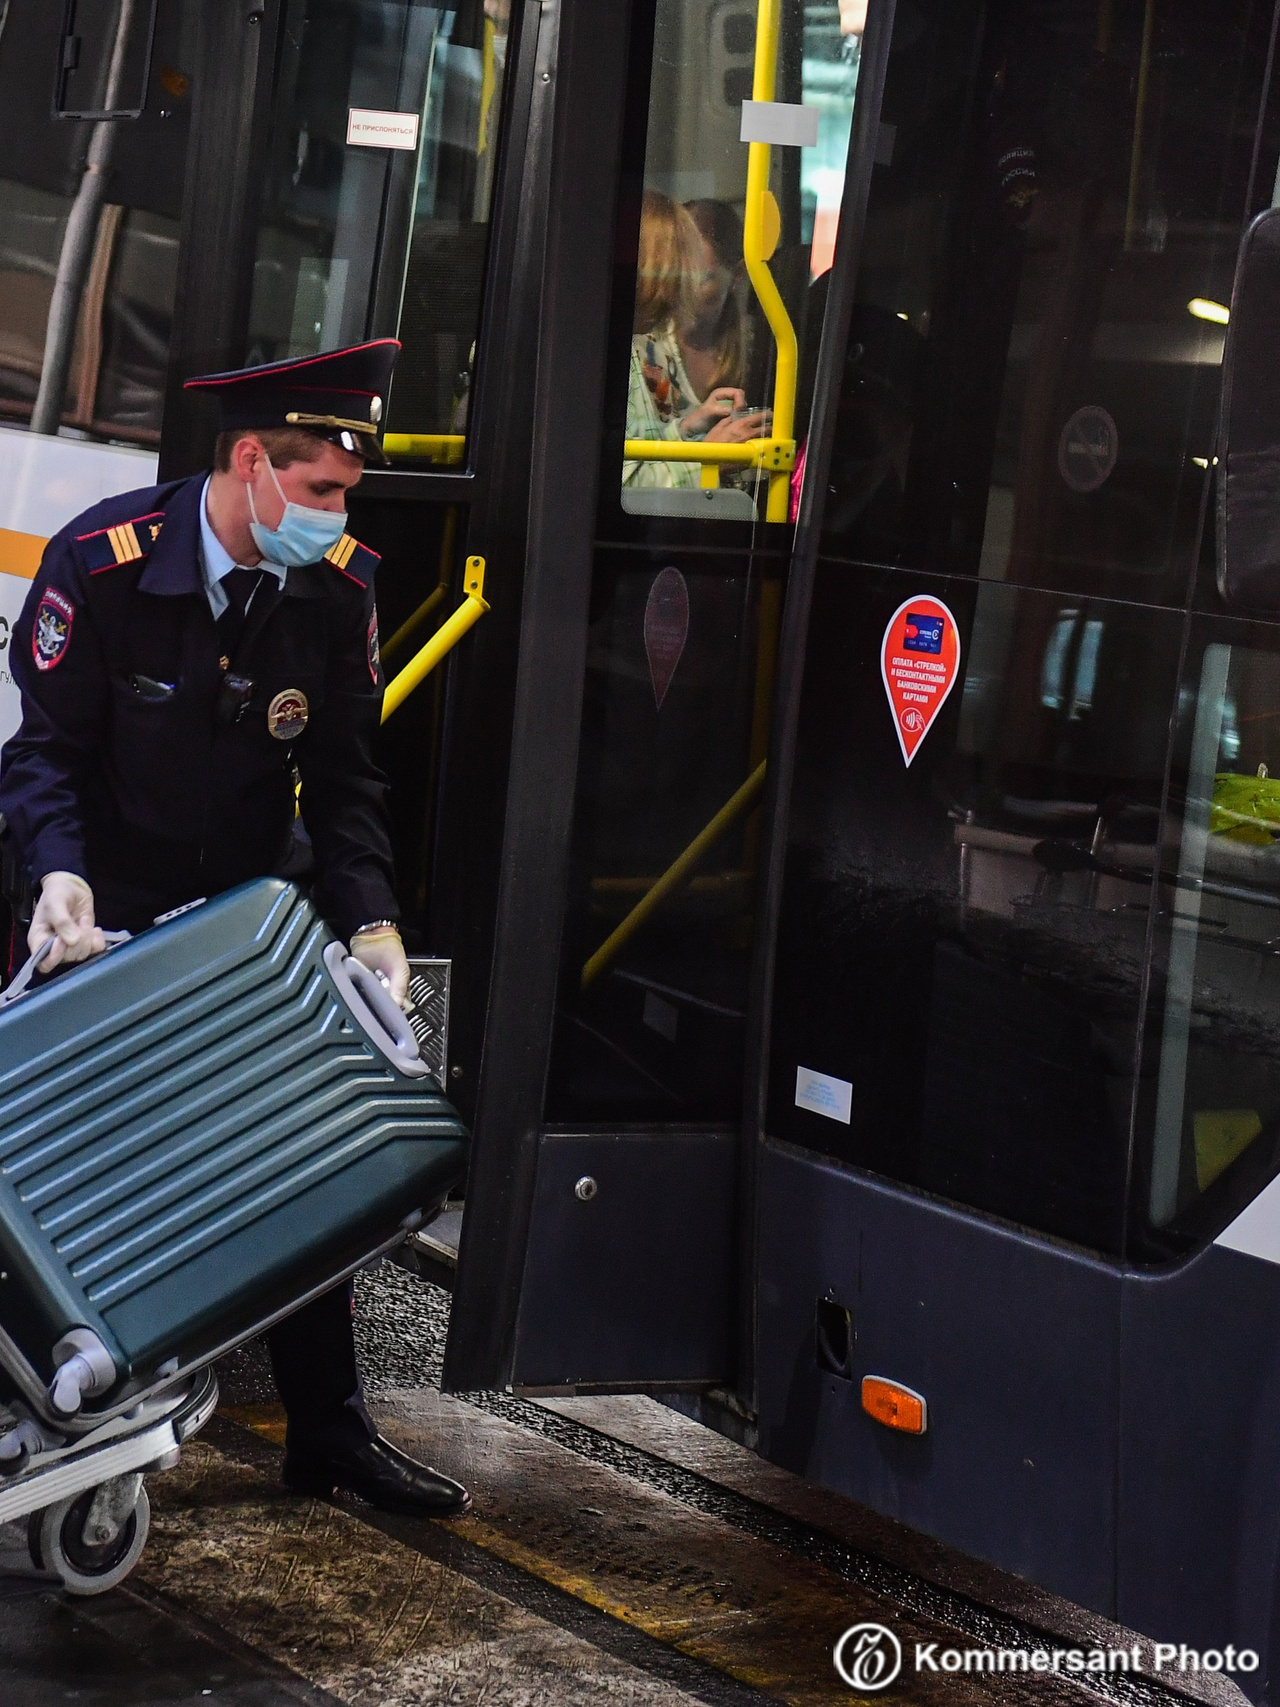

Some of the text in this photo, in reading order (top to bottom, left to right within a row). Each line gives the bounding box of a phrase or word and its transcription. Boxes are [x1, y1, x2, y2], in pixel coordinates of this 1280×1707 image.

[352, 123, 414, 135] НЕ ПРИСЛОНЯТЬСЯ
[892, 657, 913, 668] ОПЛАТА
[897, 680, 936, 693] БАНКОВСКИМИ
[902, 692, 928, 703] КАРТАМИ
